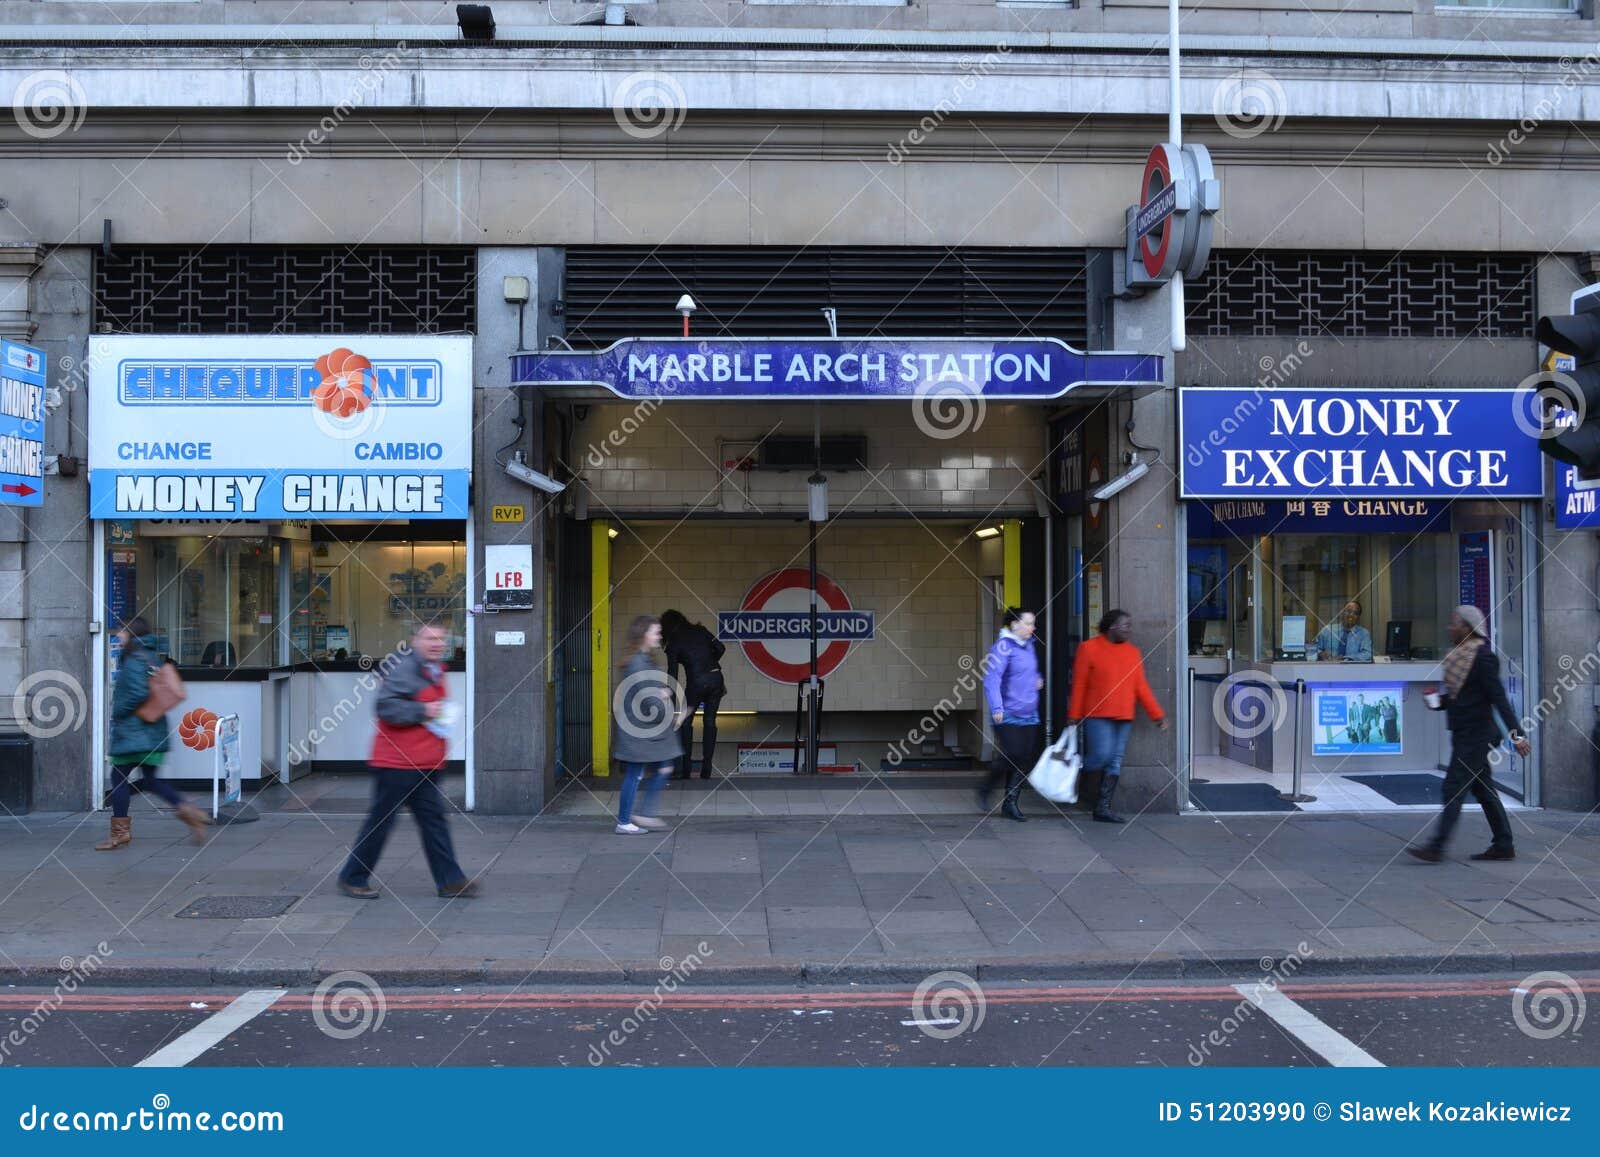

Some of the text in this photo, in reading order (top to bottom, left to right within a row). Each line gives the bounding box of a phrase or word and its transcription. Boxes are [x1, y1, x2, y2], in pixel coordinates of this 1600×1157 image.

[1137, 190, 1175, 232] UNDERGROUND
[126, 365, 435, 399] CHEQUEPINT
[627, 353, 1051, 382] MARBLE ARCH STATION
[1, 376, 43, 422] MONEY
[1269, 398, 1460, 436] MONEY
[0, 434, 43, 477] CHANGE
[117, 442, 443, 460] CHANGE CAMBIO
[1221, 449, 1509, 487] EXCHANGE
[115, 474, 444, 512] MONEY CHANGE
[1343, 500, 1429, 516] CHANGE
[1565, 491, 1595, 515] ATM
[495, 508, 521, 518] RVP
[495, 572, 523, 588] LFB
[723, 617, 869, 634] UNDERGROUND
